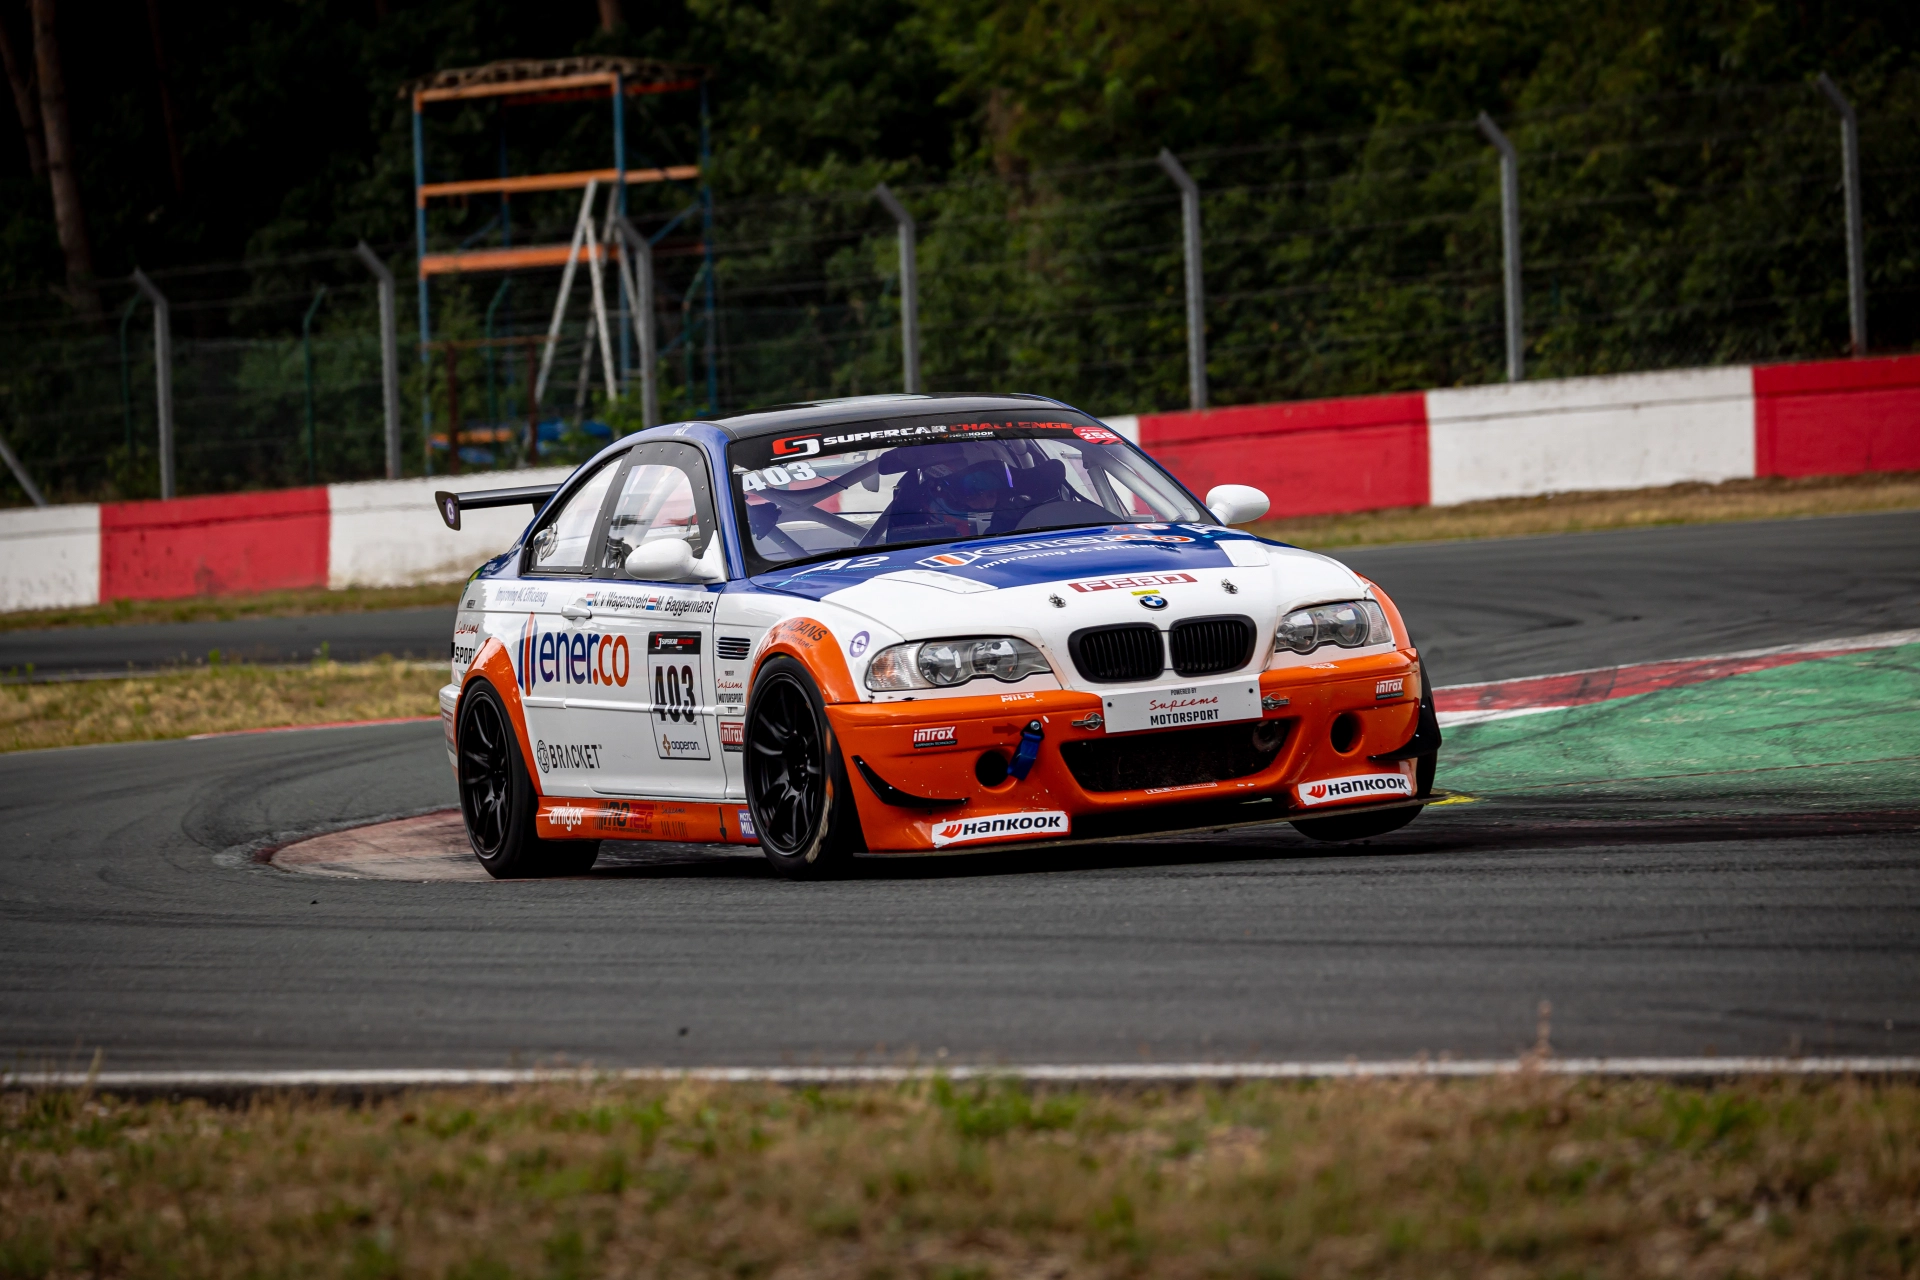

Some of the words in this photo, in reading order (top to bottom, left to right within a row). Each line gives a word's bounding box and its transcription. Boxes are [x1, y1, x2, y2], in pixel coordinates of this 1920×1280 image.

[823, 425, 949, 446] SUPERCAR
[950, 421, 1073, 432] CHALLENGE
[742, 461, 817, 491] 403
[974, 548, 1067, 570] Improving
[665, 596, 714, 616] Baggermans
[540, 631, 630, 687] ener.co
[653, 665, 697, 722] 403
[1170, 687, 1190, 696] POWERED
[1190, 687, 1198, 695] BY
[1149, 696, 1219, 712] Supreme
[1150, 709, 1220, 726] MOTORSPORT
[549, 802, 585, 831] amigos
